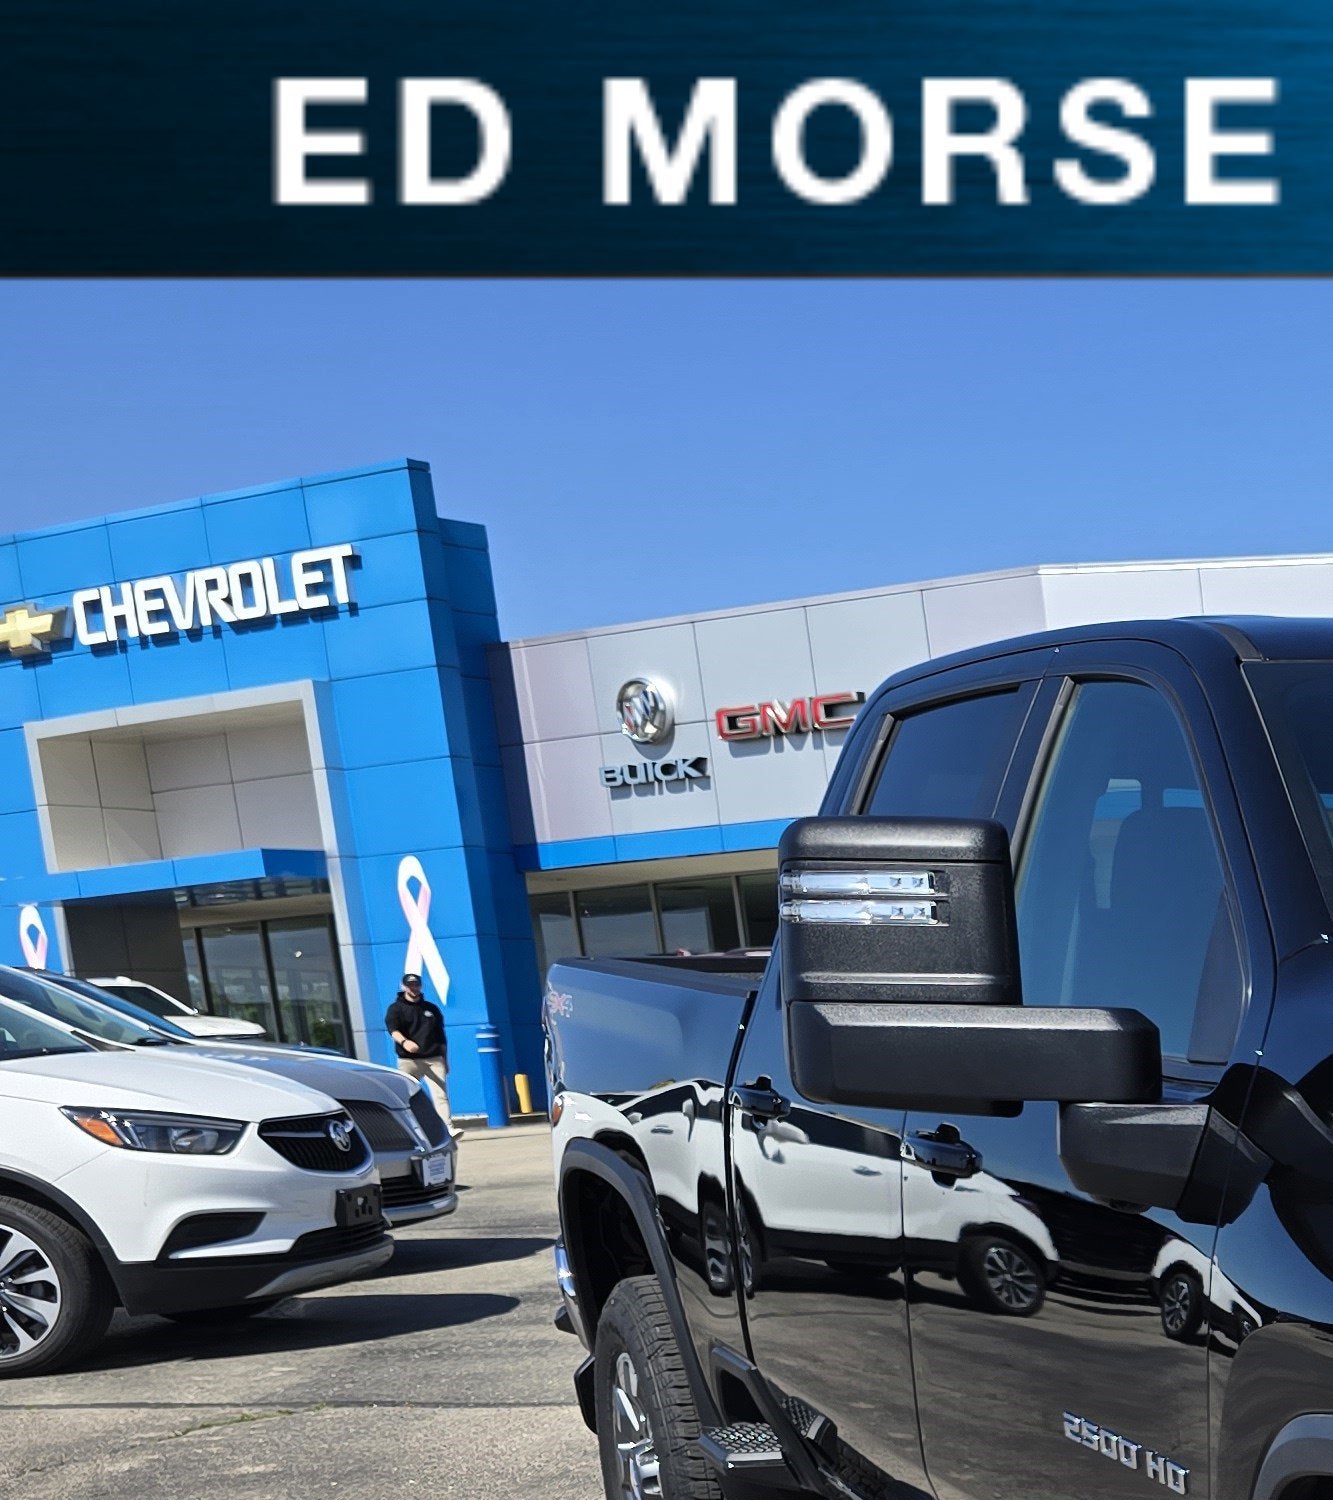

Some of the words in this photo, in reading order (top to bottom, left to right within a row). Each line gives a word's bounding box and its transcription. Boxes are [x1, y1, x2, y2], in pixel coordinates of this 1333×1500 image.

[72, 543, 354, 647] CHEVROLET
[715, 691, 857, 741] GMC
[600, 758, 704, 788] BUICK
[1062, 1409, 1141, 1470] 2500
[1145, 1450, 1190, 1495] HD
